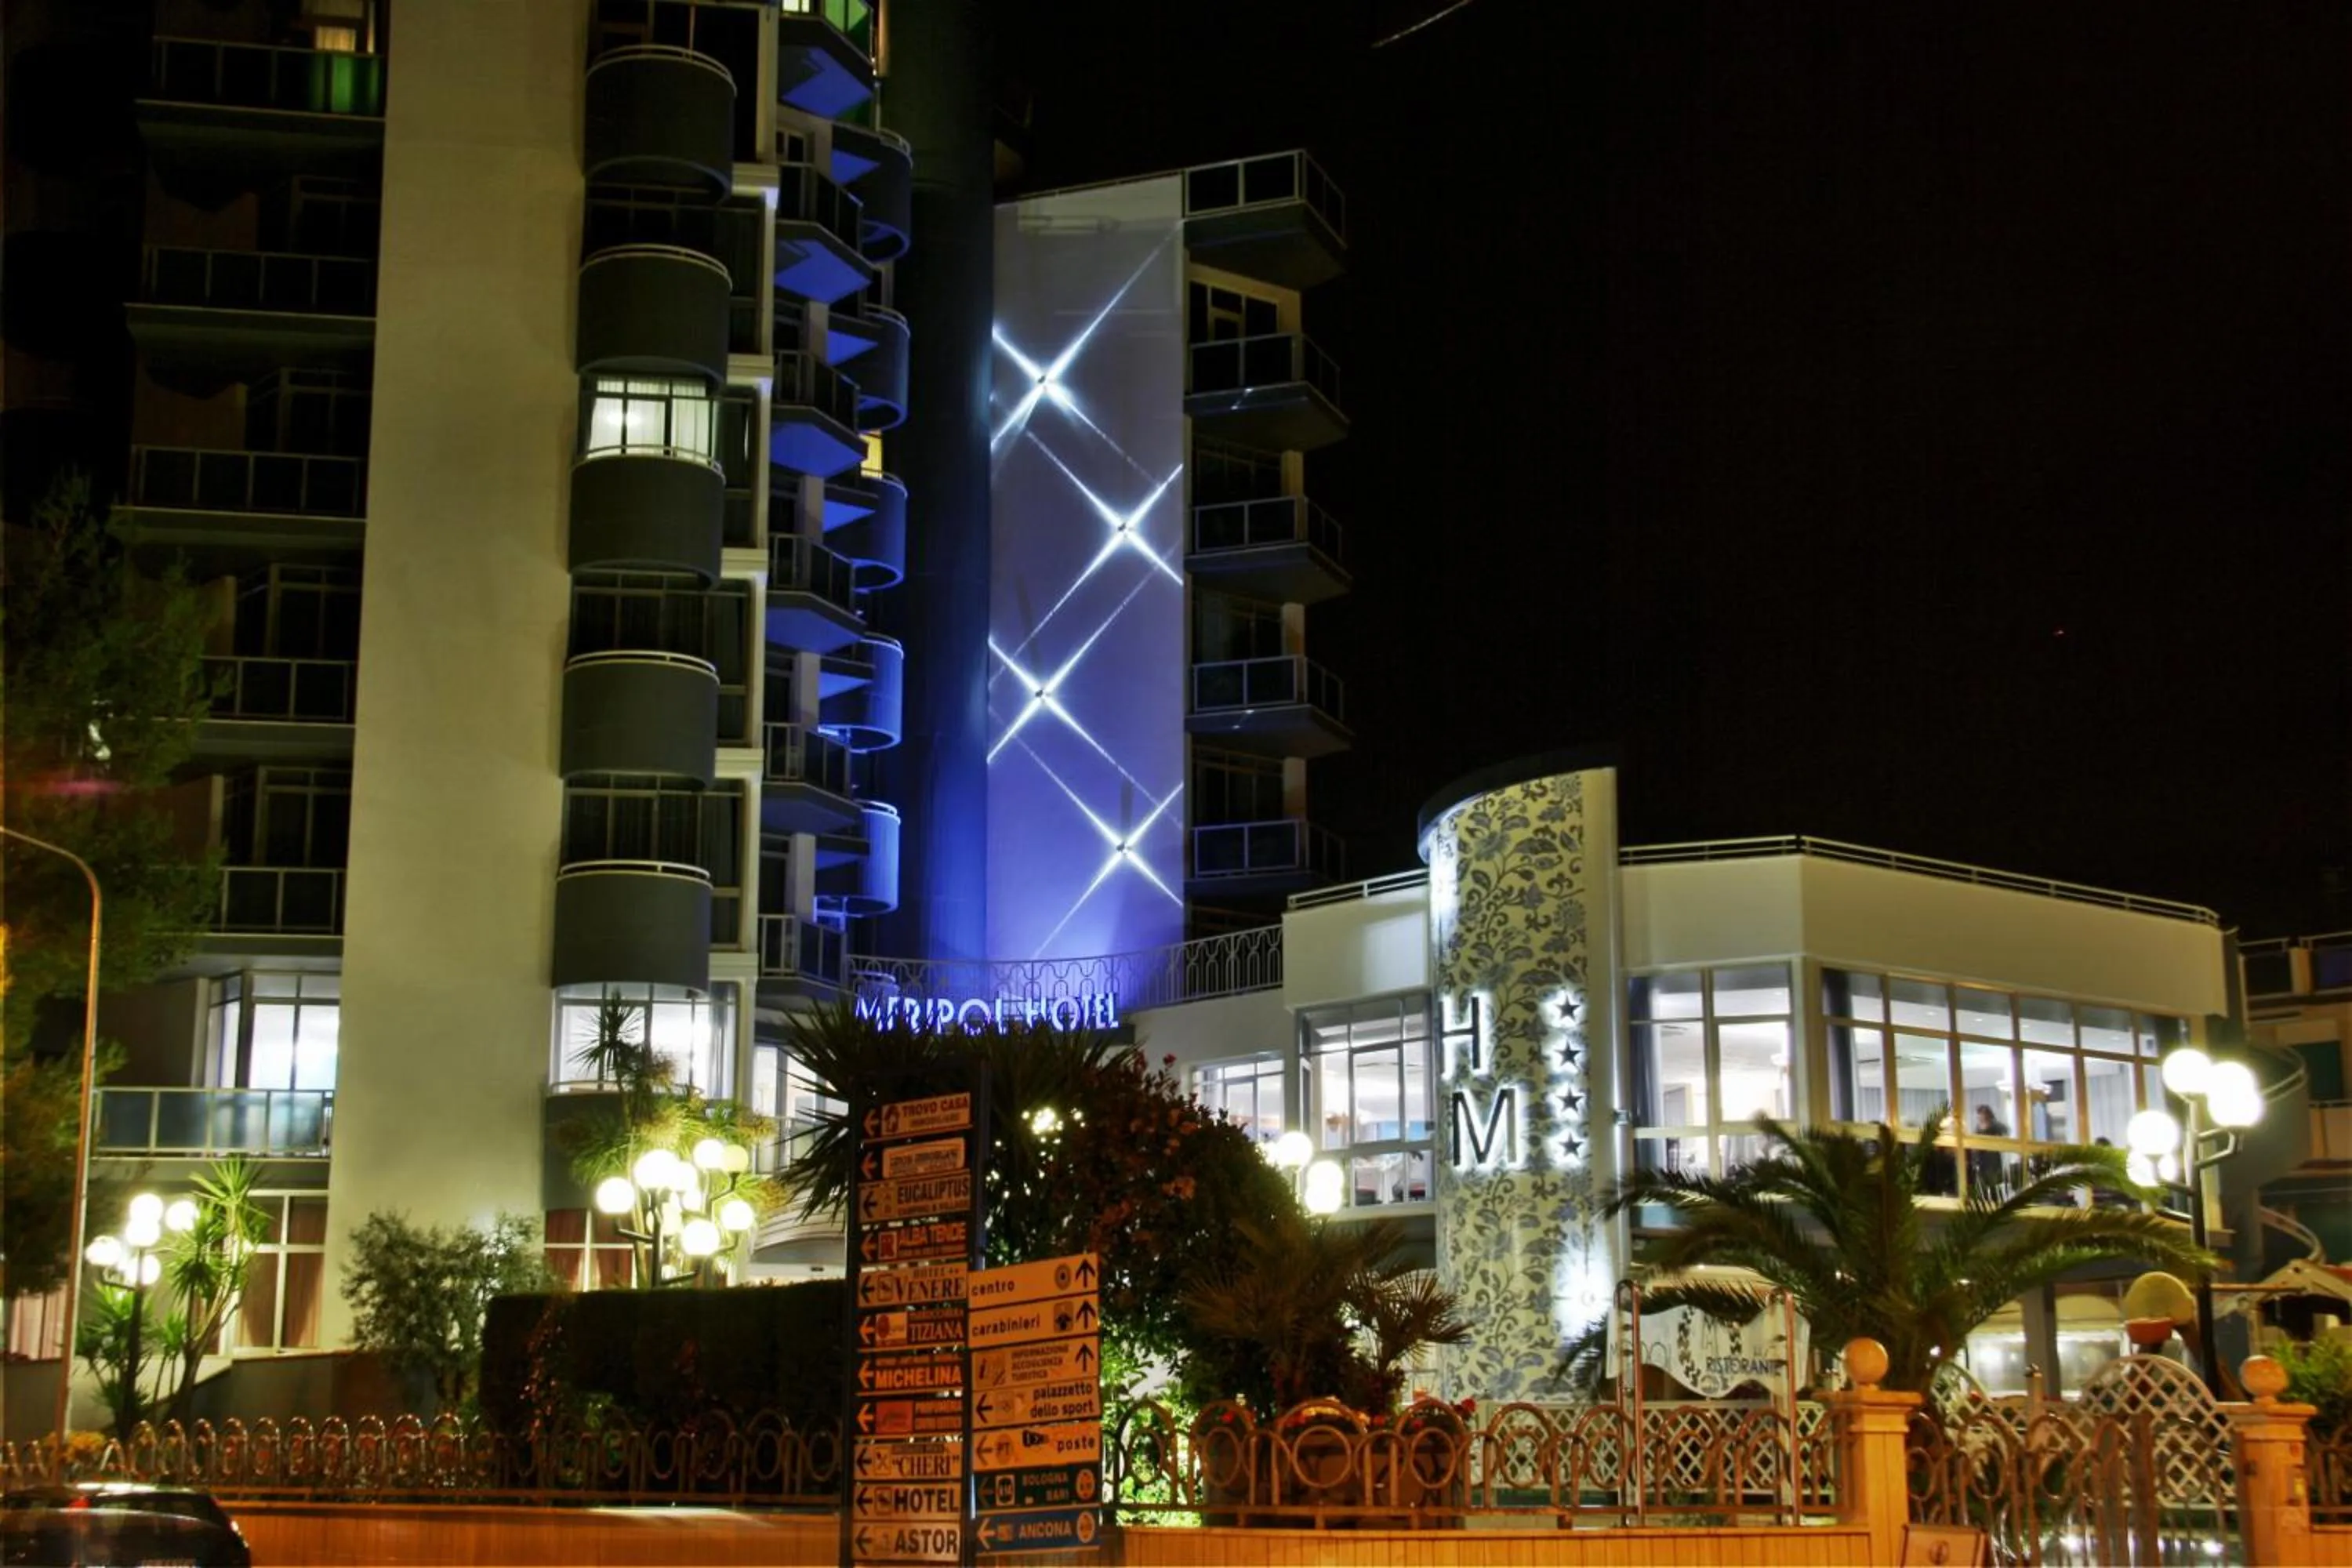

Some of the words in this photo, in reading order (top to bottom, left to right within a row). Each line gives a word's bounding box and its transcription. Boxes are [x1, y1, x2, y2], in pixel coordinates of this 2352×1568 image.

[1439, 996, 1480, 1076] H
[1453, 1087, 1517, 1167] M
[898, 1176, 968, 1204] EUCALIPTUS
[895, 1277, 964, 1302] VENERE
[971, 1279, 1014, 1296] centro
[909, 1320, 964, 1342] TIZIANA
[972, 1312, 1040, 1337] carabinieri
[875, 1365, 963, 1388] MICHELINA
[1033, 1381, 1093, 1402] palazzetto
[1029, 1403, 1058, 1419] dello
[1062, 1399, 1094, 1417] sport
[1057, 1436, 1095, 1454] poste
[894, 1487, 960, 1514] HOTEL
[894, 1529, 958, 1555] ASTOR
[1019, 1521, 1073, 1539] ANCONA
